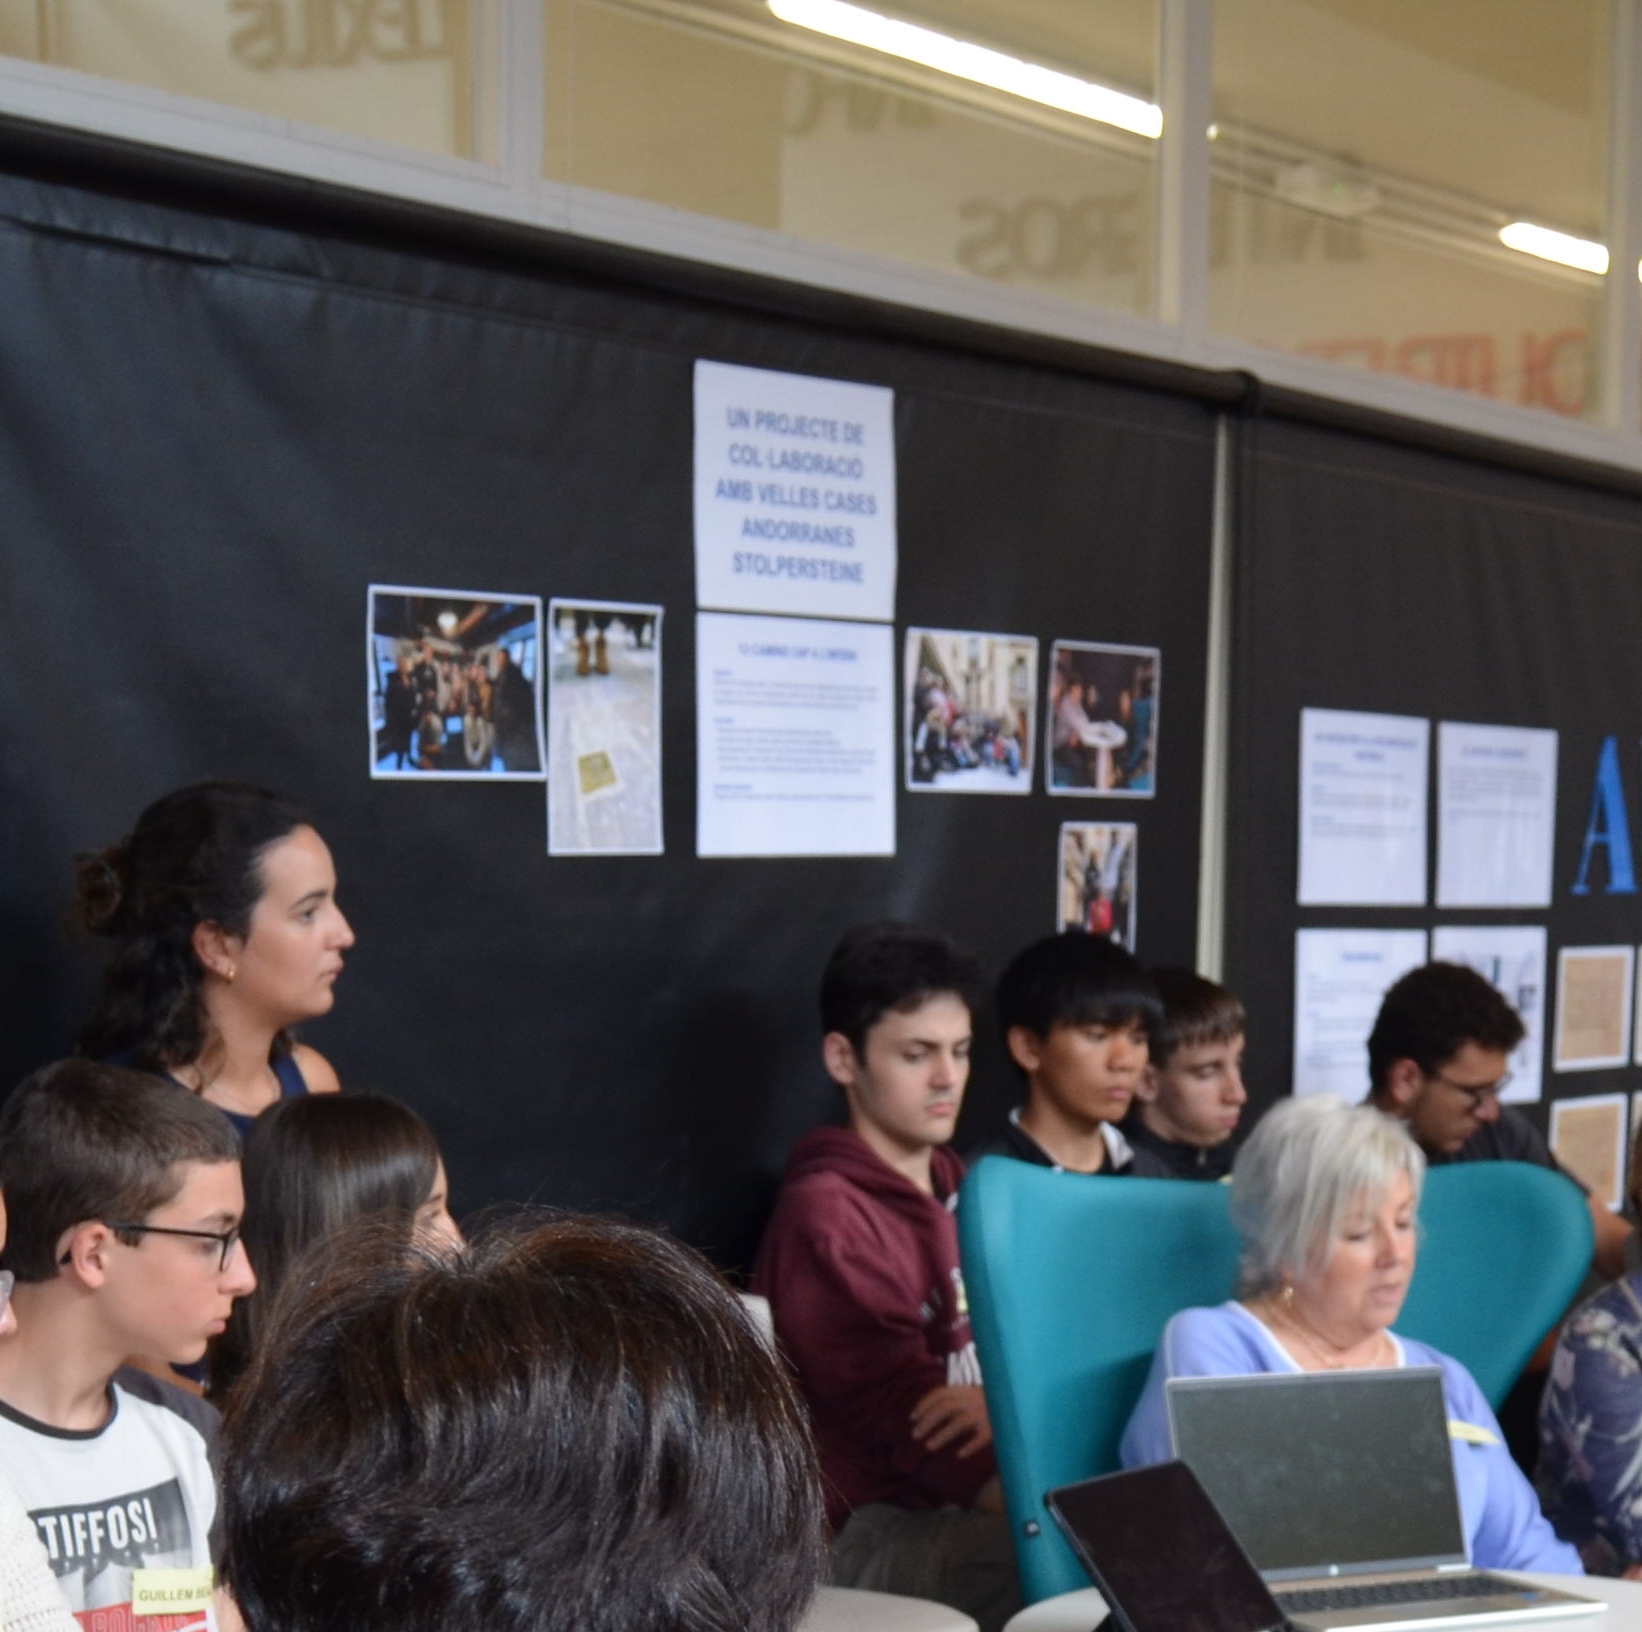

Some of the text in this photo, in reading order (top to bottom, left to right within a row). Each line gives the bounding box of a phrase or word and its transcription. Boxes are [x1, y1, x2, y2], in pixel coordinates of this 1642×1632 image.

[726, 408, 864, 446] UN PROJECTE DE
[715, 478, 878, 517] AMB VELLES CASES
[742, 517, 856, 548] ANDORRANES
[733, 551, 864, 585] STOLPERSTEINE
[37, 1496, 158, 1561] TIFFOSI
[139, 1587, 193, 1603] GUILLEM
